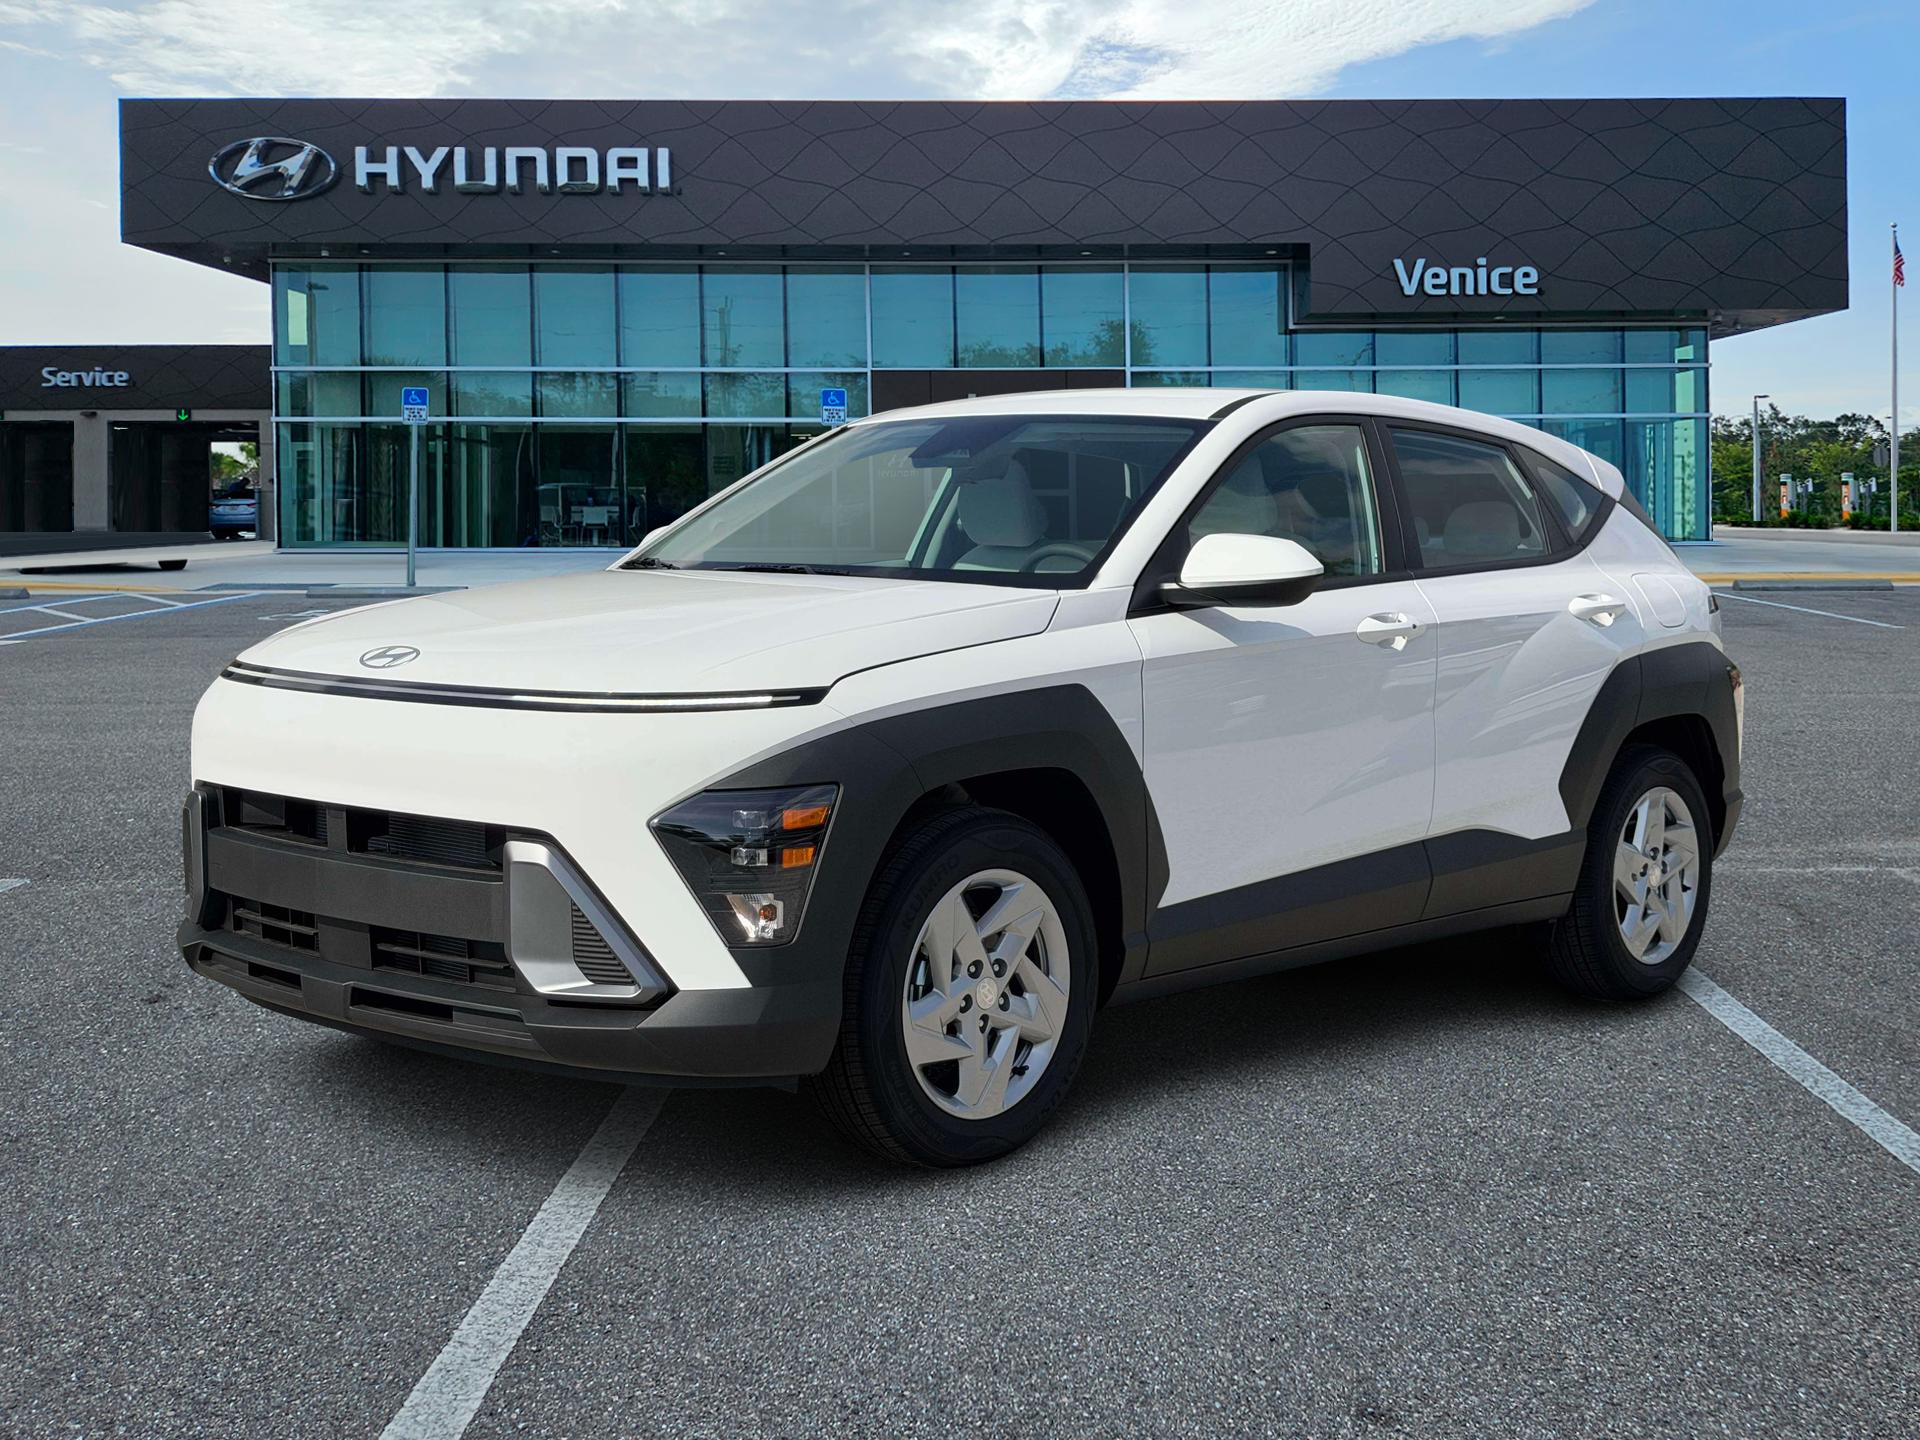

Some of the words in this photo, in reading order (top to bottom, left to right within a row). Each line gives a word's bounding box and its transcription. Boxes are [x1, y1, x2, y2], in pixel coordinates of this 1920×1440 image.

[354, 146, 672, 194] HYUNDAI
[1392, 256, 1539, 296] Venice
[41, 366, 129, 387] Service
